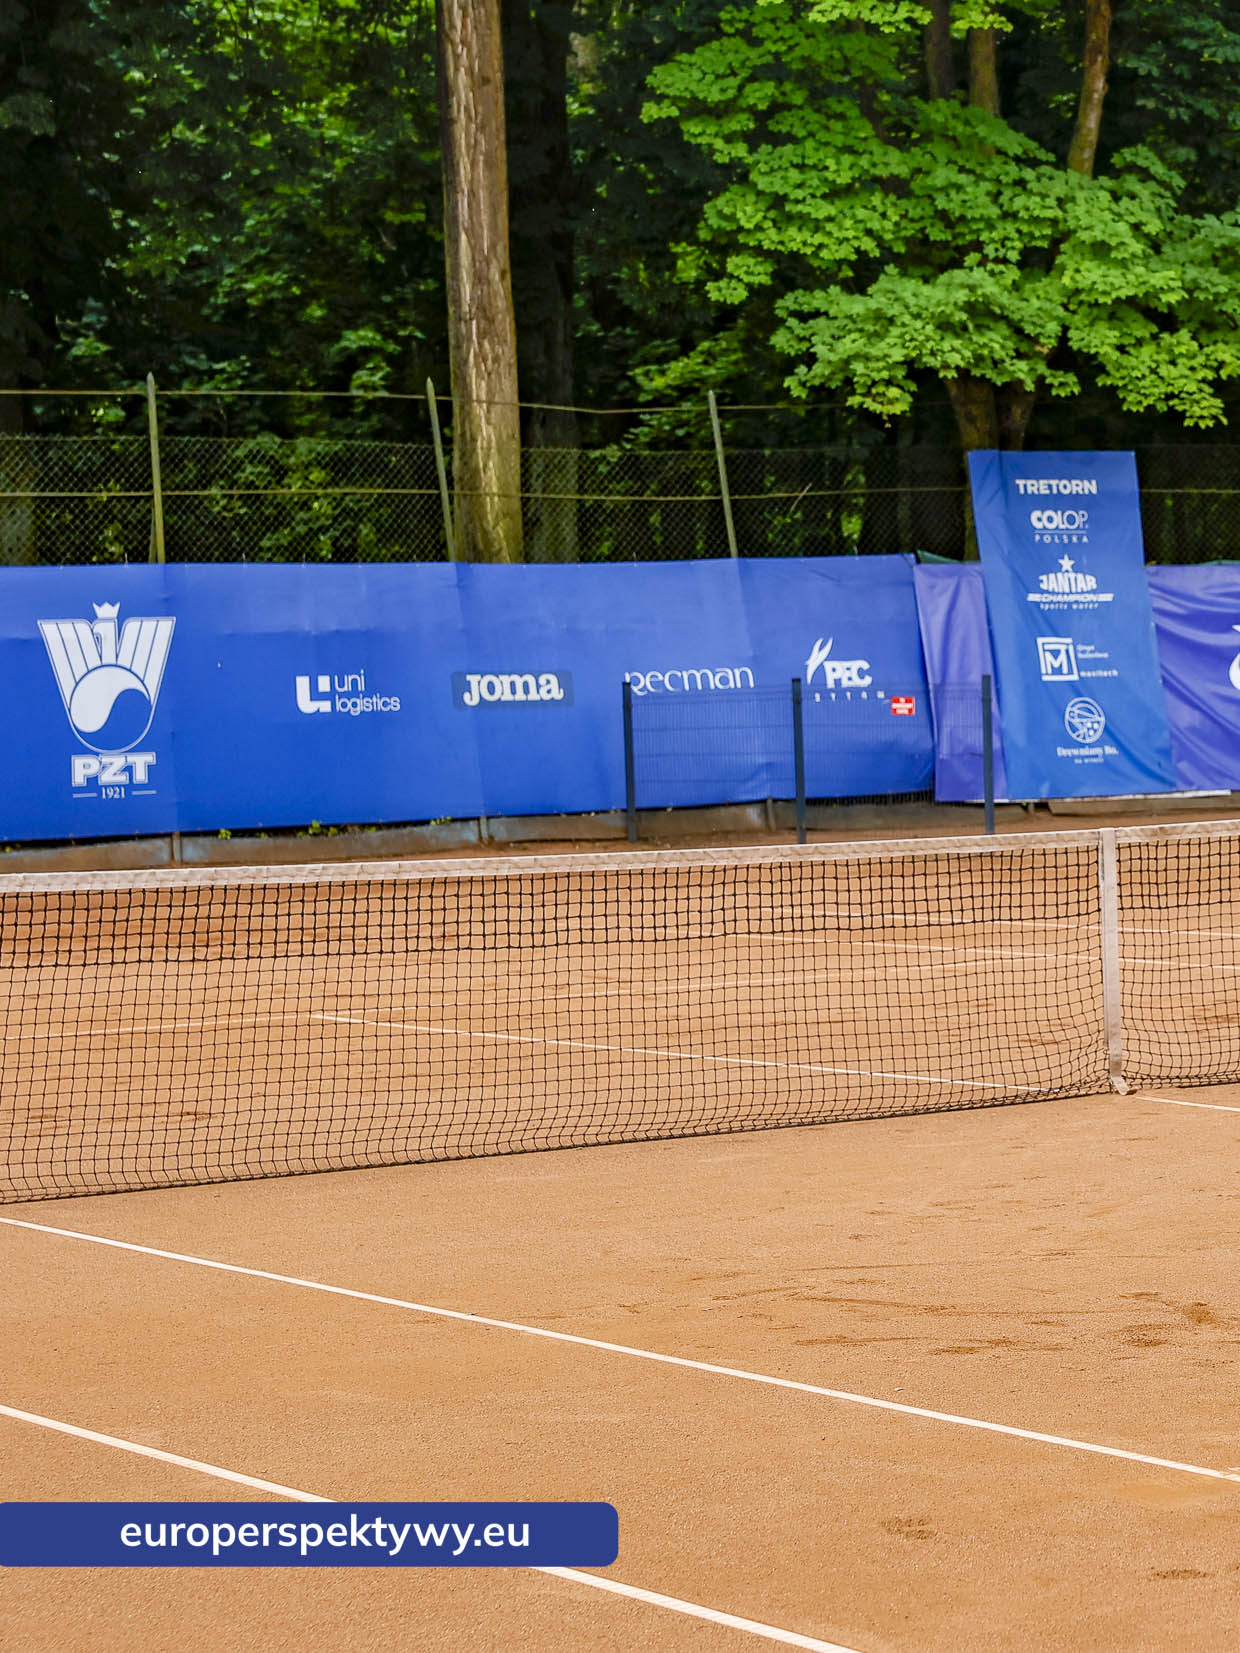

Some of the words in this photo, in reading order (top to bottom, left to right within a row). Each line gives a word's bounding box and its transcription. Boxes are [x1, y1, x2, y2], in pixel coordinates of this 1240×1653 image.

[1015, 479, 1098, 495] TRETORN
[1030, 510, 1088, 529] COLOP
[1035, 534, 1089, 543] POLSKA
[1039, 572, 1098, 593] JANTAR
[334, 669, 365, 692] uni
[823, 659, 873, 688] PEC
[335, 693, 401, 716] logistics
[72, 752, 156, 787] PZT
[101, 786, 125, 799] 1921
